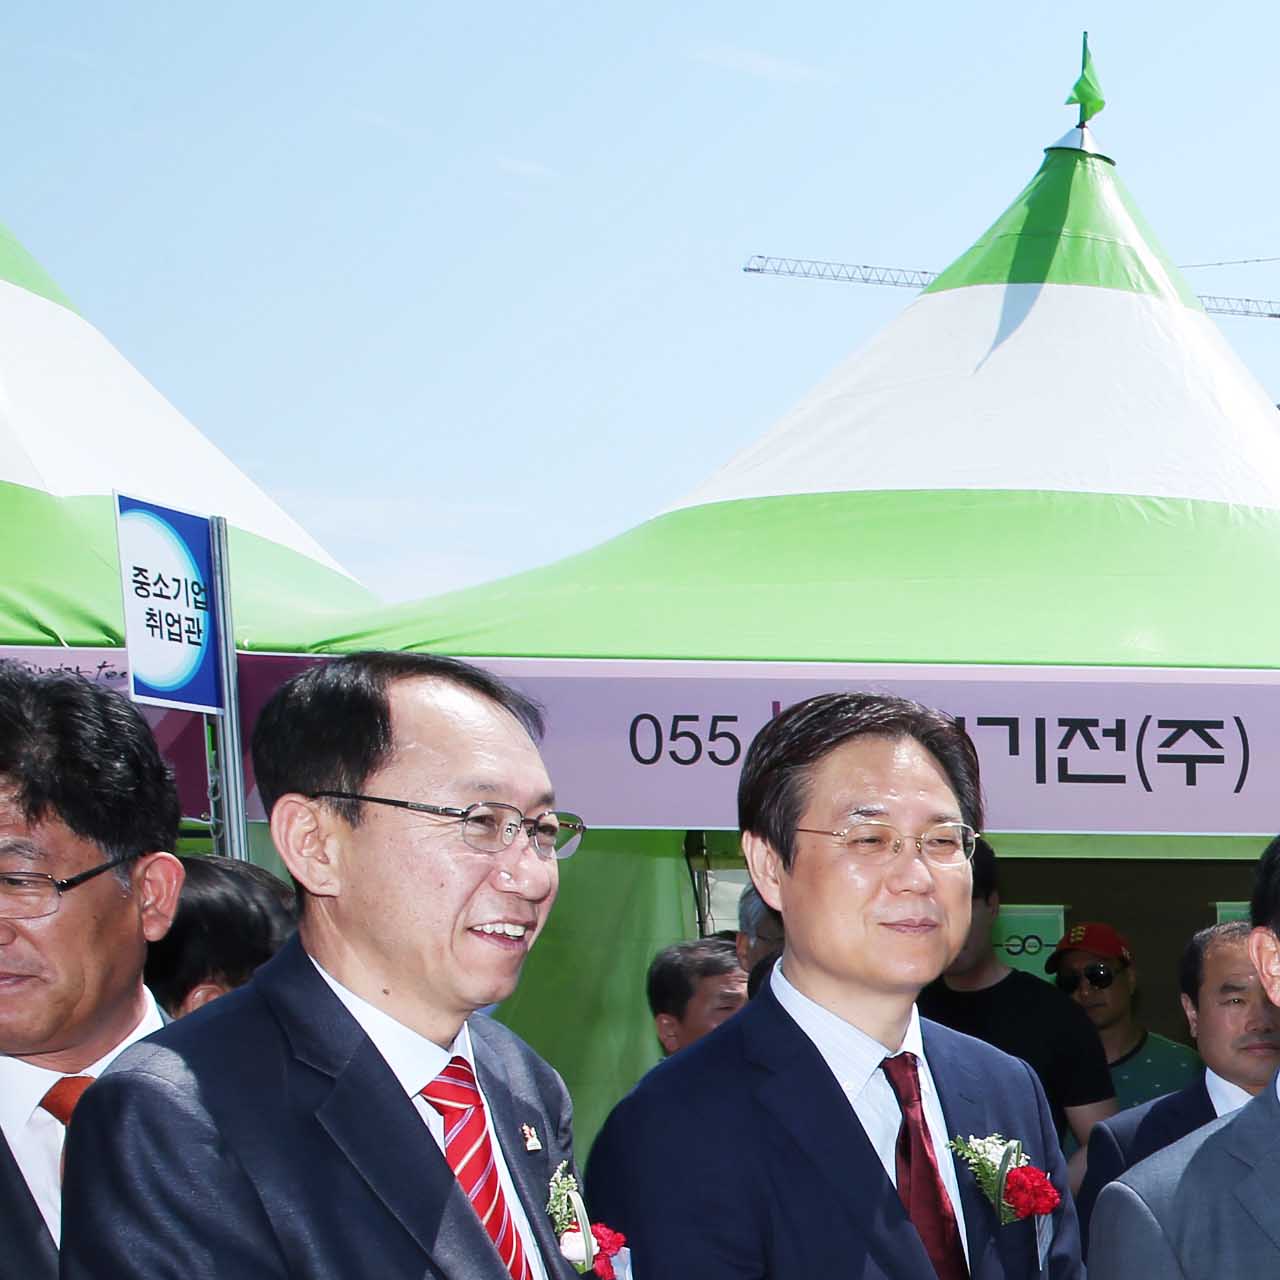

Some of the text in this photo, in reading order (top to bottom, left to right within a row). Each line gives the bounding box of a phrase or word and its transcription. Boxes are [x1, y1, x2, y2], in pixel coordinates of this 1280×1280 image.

[132, 566, 208, 612] 중소기업
[145, 607, 203, 647] 취업관
[629, 713, 1250, 793] 055 기전(주)
